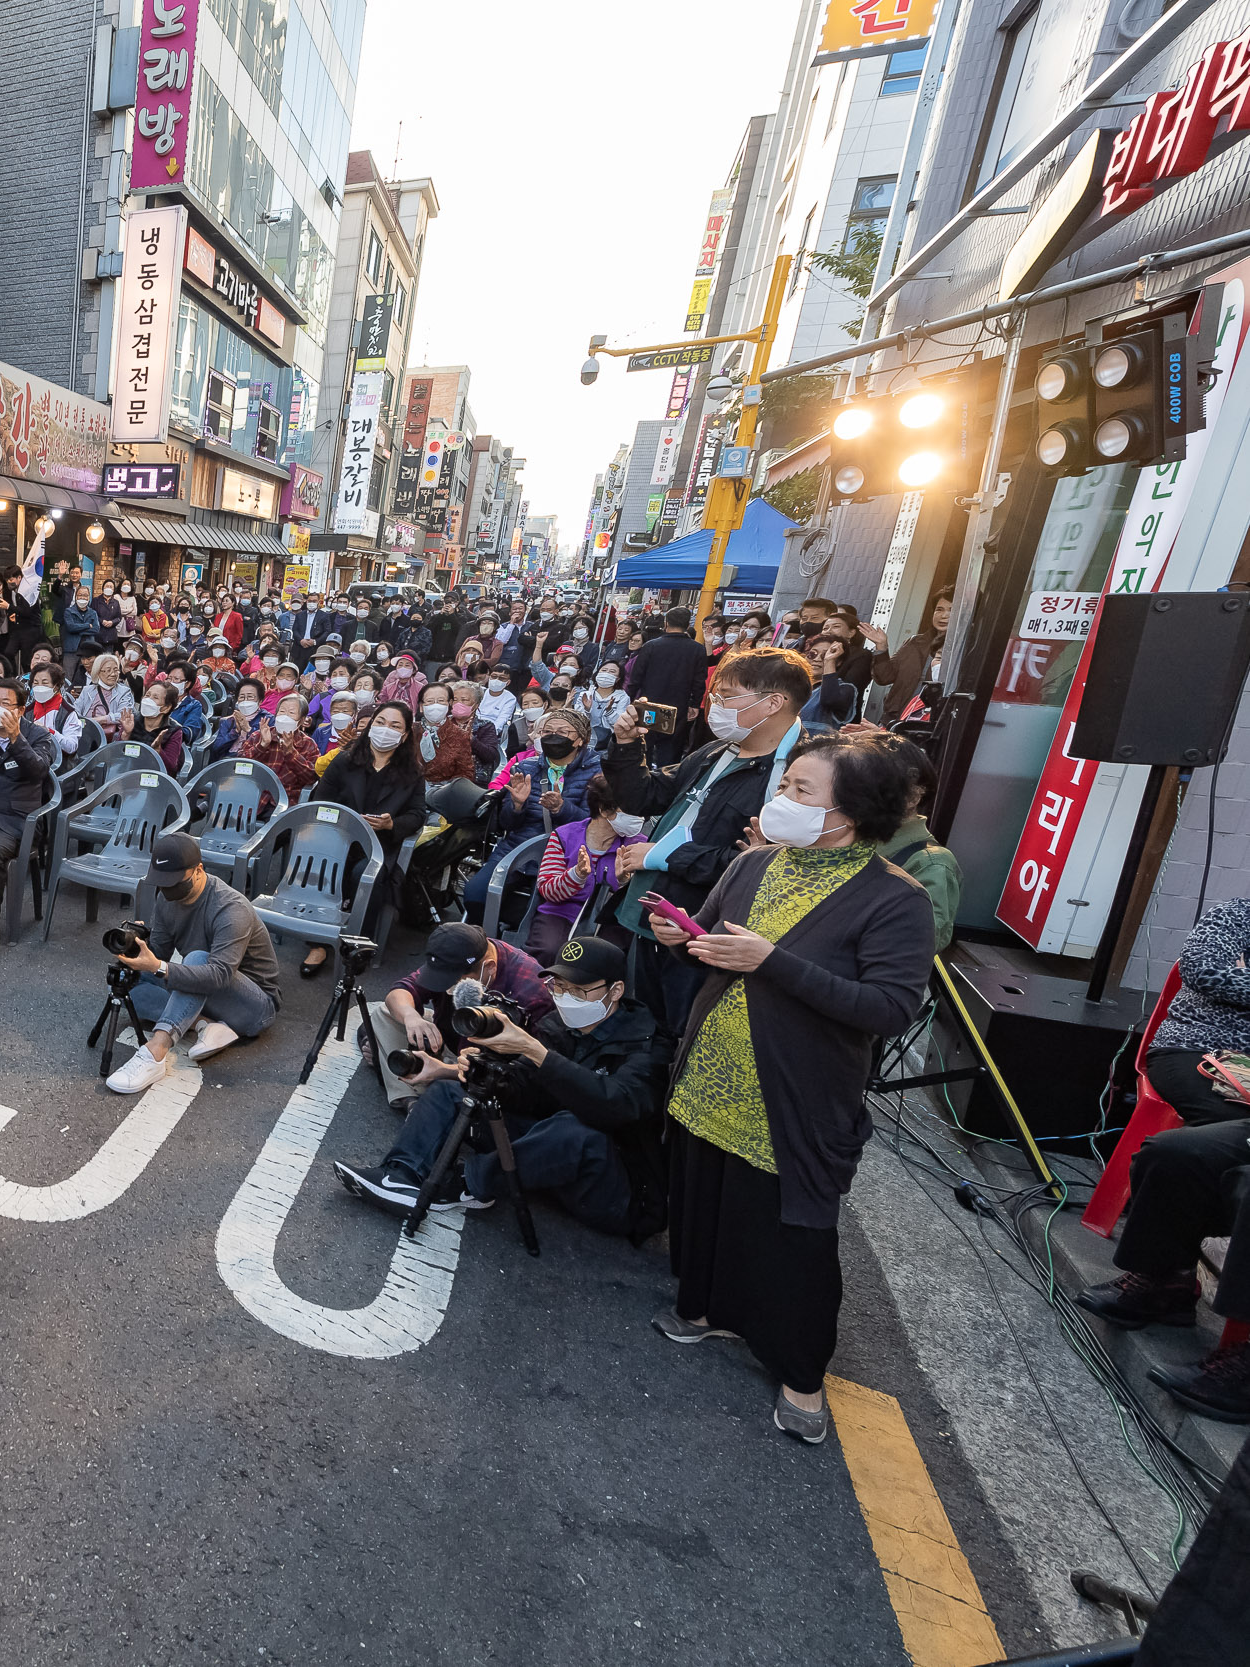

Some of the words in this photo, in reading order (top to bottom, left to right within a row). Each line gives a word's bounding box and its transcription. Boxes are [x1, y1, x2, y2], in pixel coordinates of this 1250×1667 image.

[700, 215, 724, 267] 마사지
[654, 353, 681, 366] CCTV
[682, 348, 711, 363] 작동중
[1170, 352, 1182, 383] COB
[1170, 386, 1182, 423] 400W
[344, 418, 372, 507] 대봉갈비
